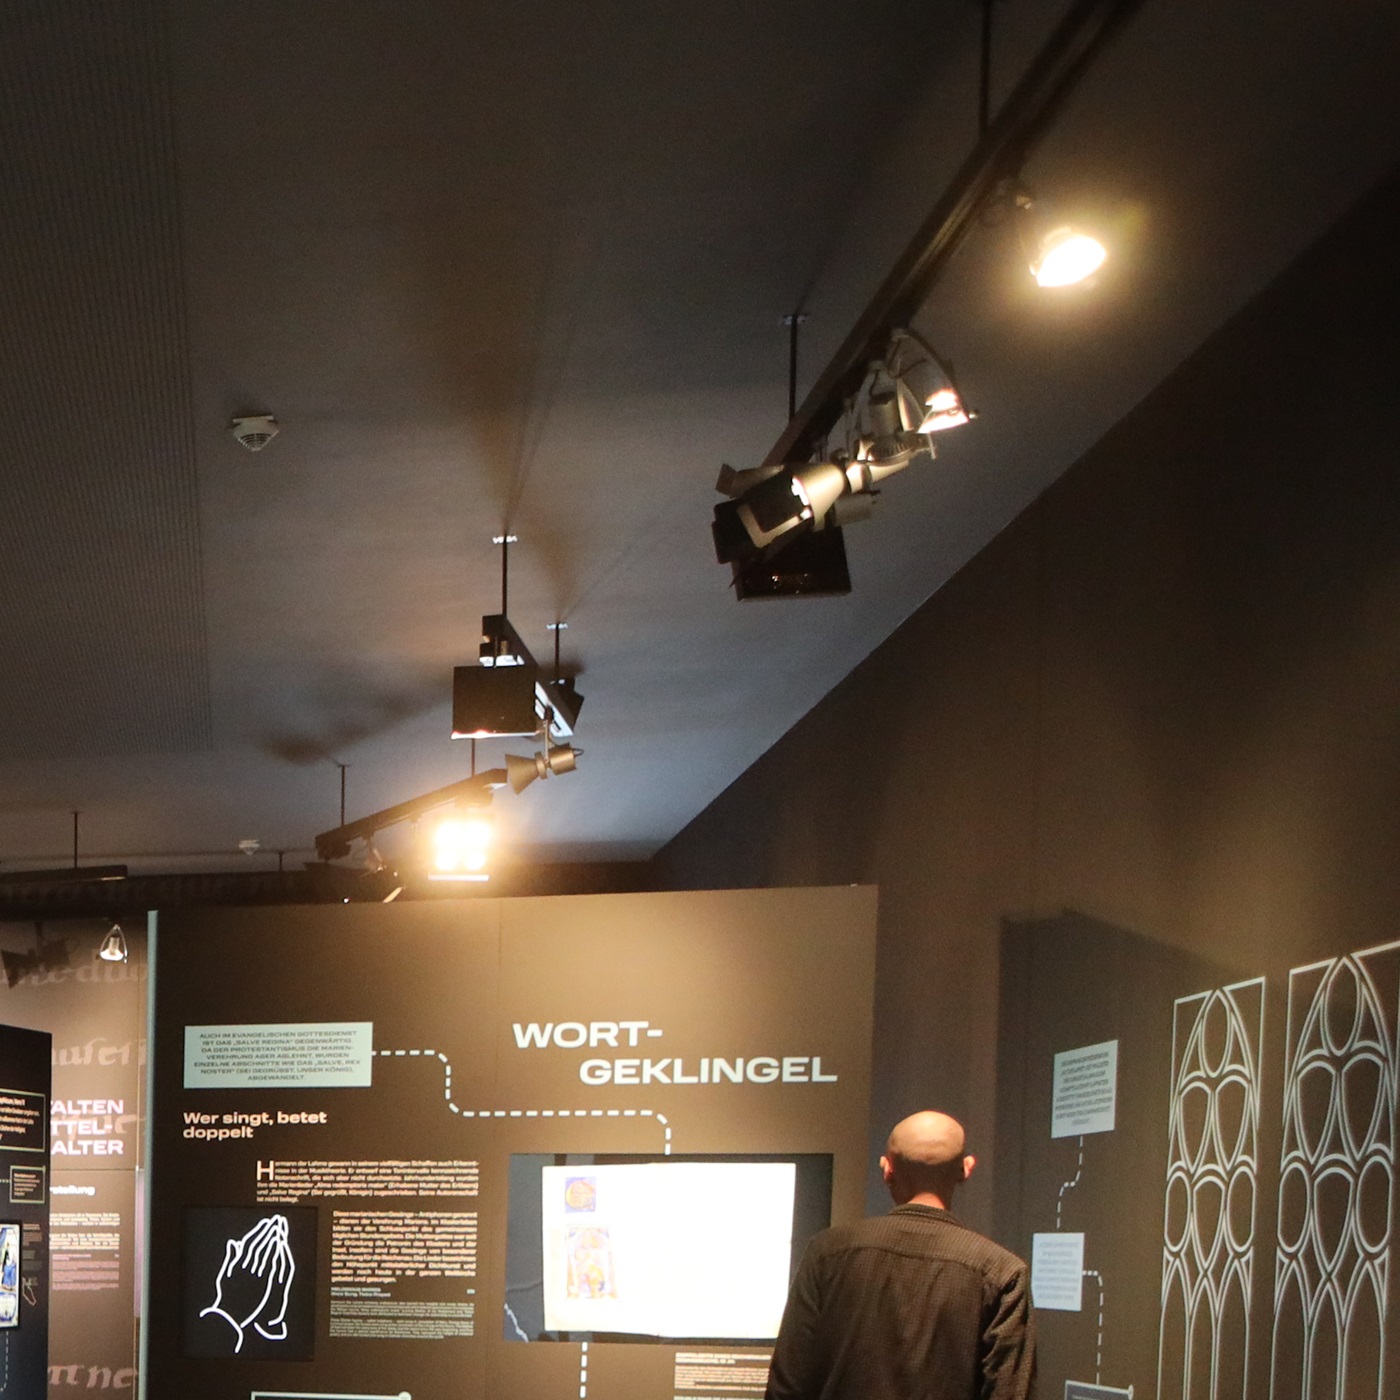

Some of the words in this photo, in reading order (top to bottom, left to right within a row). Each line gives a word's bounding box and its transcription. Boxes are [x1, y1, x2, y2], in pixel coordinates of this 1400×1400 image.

[512, 1020, 664, 1049] WORT-
[579, 1056, 838, 1085] GEKLINGEL
[50, 1099, 124, 1115] ALTEN
[183, 1112, 220, 1125] Wer
[223, 1111, 274, 1127] singt,
[277, 1110, 327, 1125] betet
[183, 1125, 254, 1141] doppelt
[51, 1140, 124, 1155] ALTER
